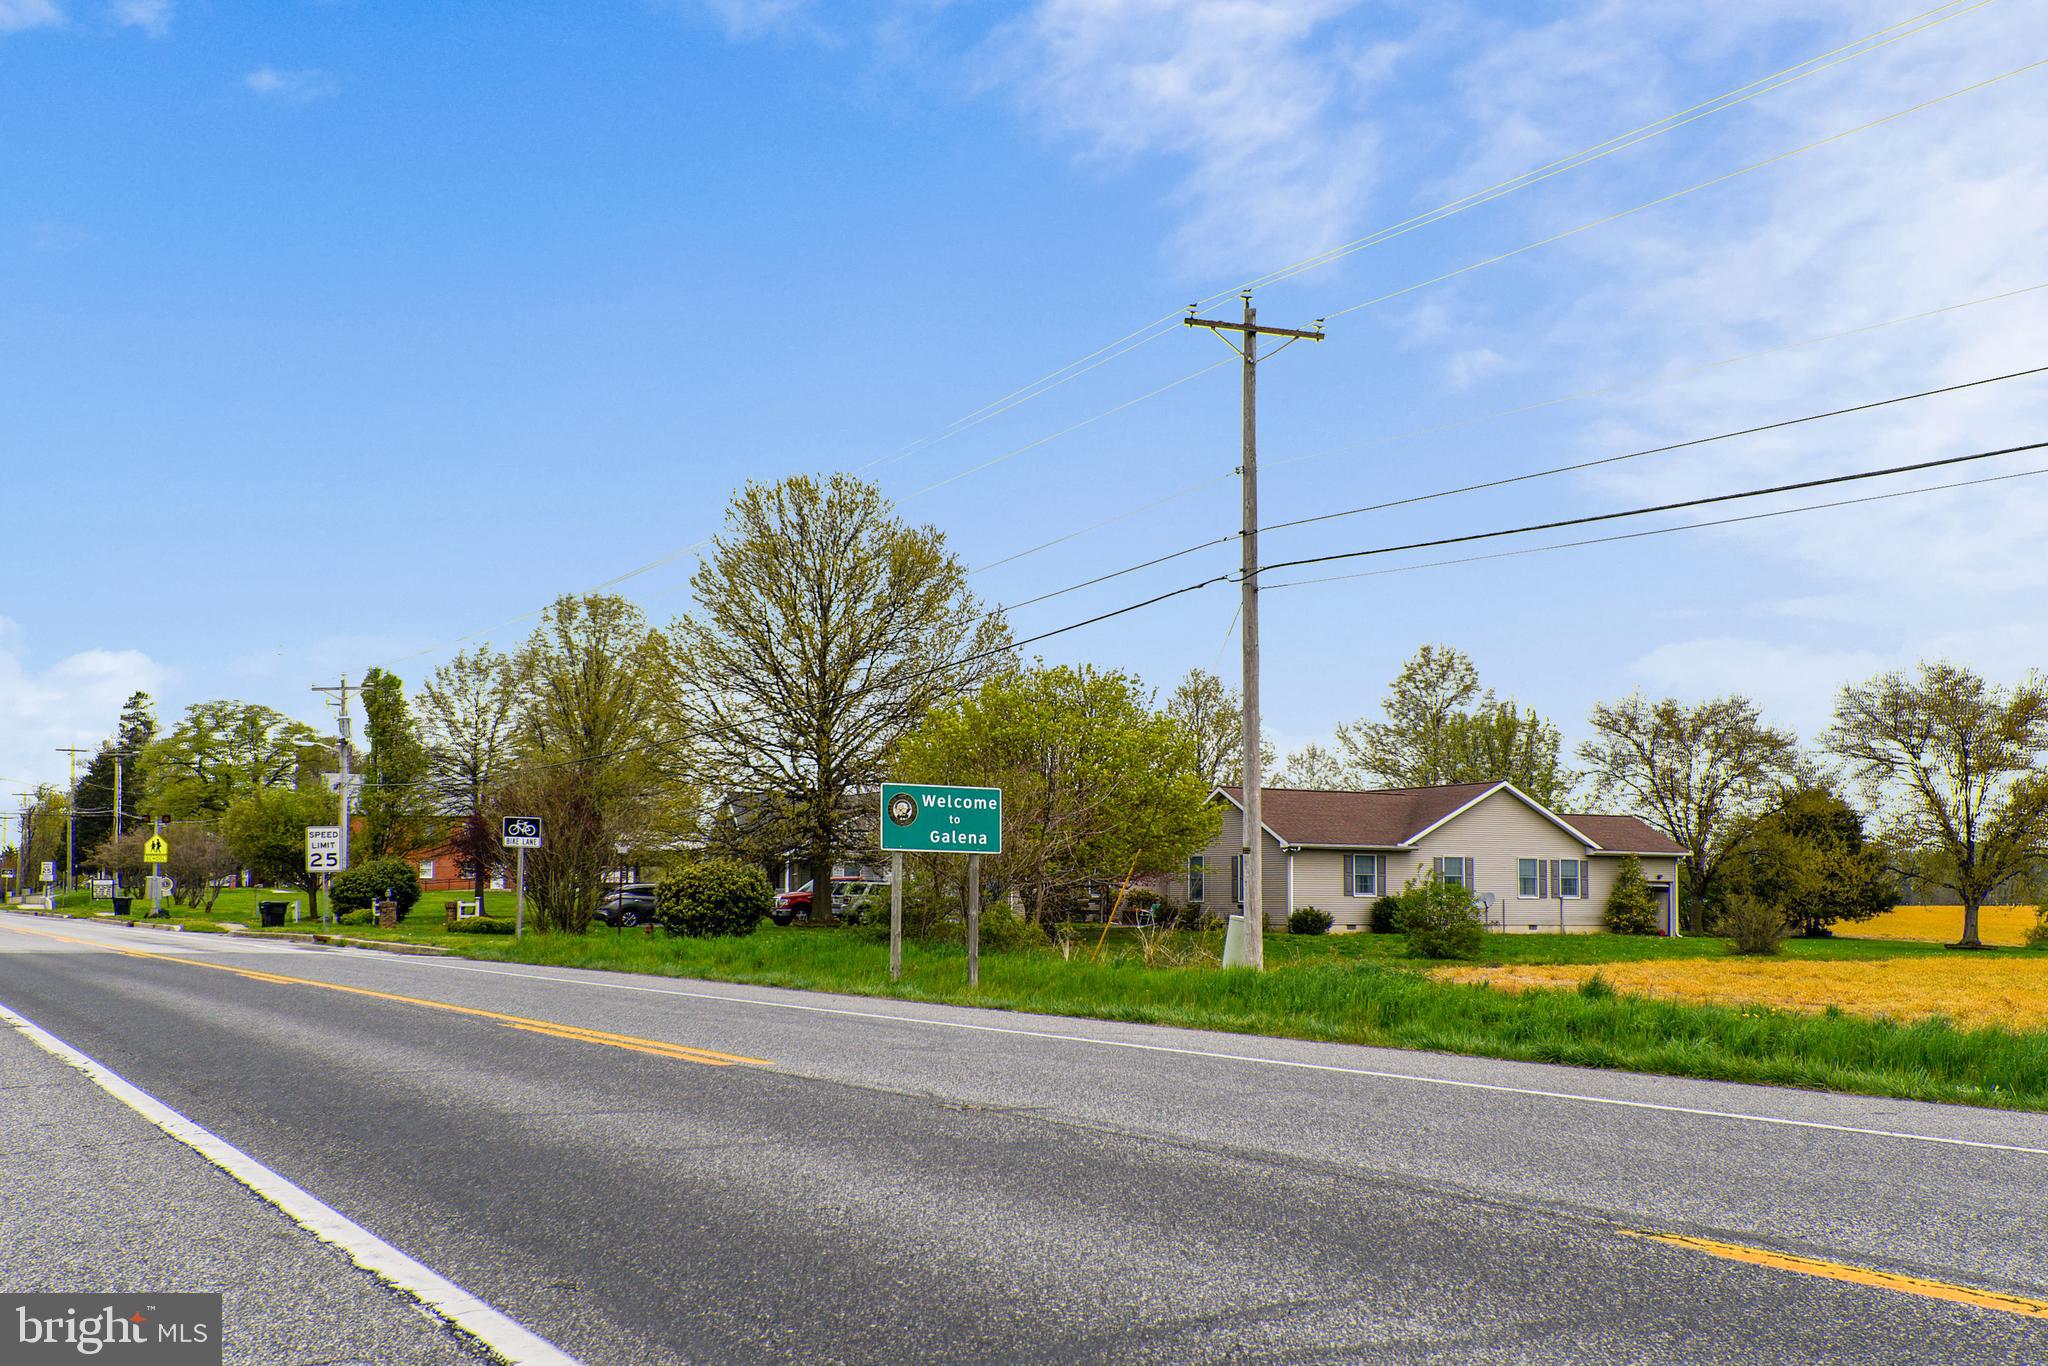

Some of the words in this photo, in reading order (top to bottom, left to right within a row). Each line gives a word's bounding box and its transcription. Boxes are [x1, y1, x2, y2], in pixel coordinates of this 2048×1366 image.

[922, 794, 997, 809] Welcome
[949, 815, 961, 824] to
[522, 838, 537, 846] LANE
[930, 830, 987, 844] Galena
[311, 853, 338, 867] 25
